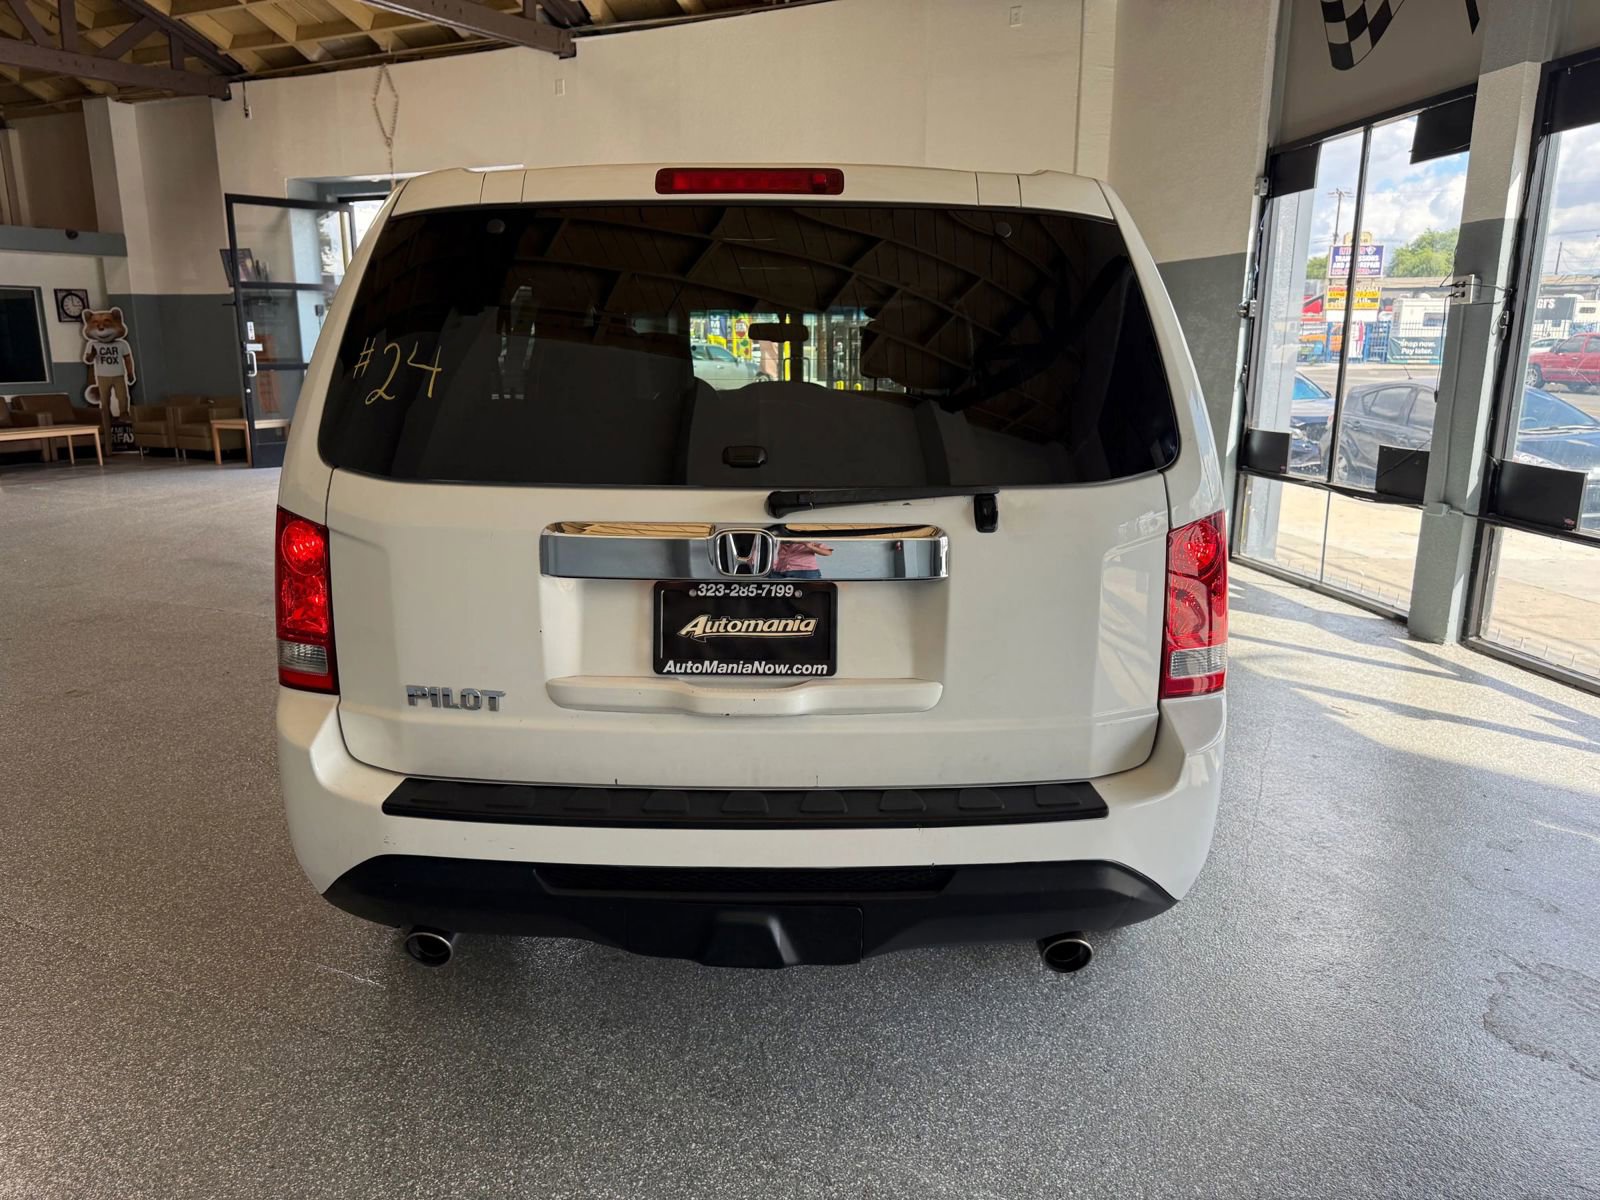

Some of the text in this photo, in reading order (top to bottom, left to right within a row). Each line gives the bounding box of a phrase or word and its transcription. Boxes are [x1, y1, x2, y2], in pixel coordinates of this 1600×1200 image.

[99, 346, 119, 355] CAR
[1401, 347, 1415, 355] Pay
[100, 356, 119, 365] FOX
[353, 337, 443, 405] #24
[697, 583, 795, 598] 323-285-7199
[678, 613, 818, 639] Automania
[662, 660, 828, 676] AutoManiaNow.com
[405, 684, 507, 713] PILOT
